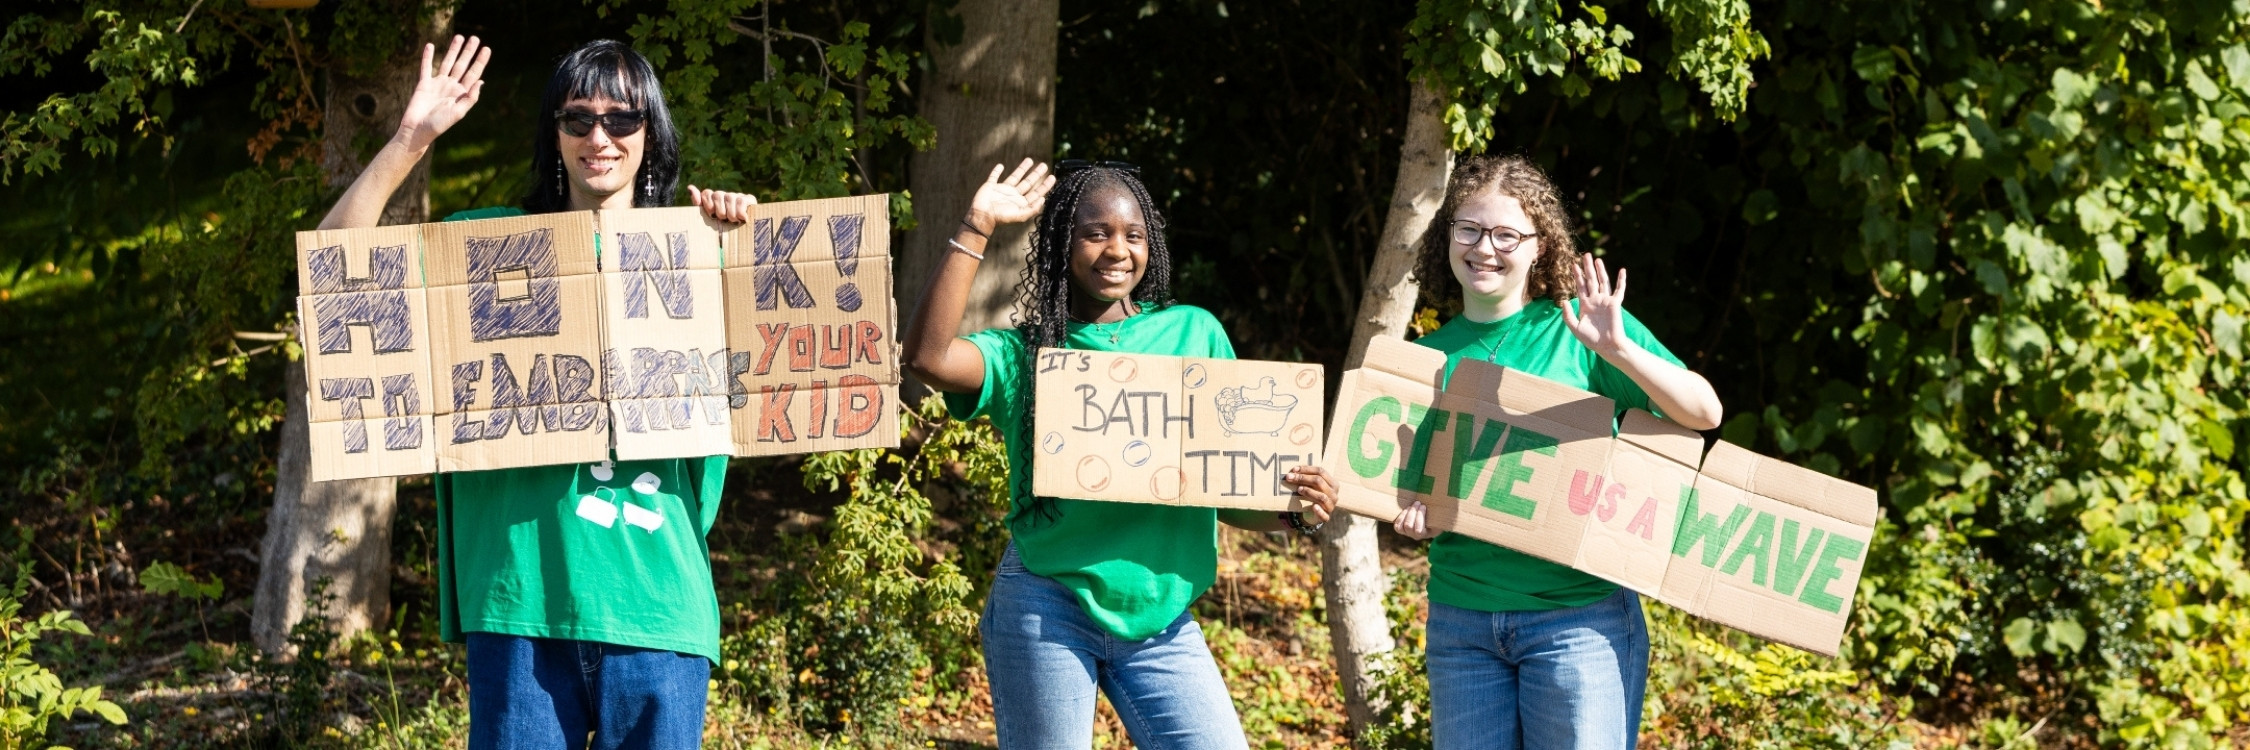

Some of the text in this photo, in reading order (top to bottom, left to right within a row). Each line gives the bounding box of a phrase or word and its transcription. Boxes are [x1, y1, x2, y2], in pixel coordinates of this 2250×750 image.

[306, 212, 865, 355] HONK!
[753, 320, 882, 376] YOUR
[1039, 350, 1093, 375] IT'S
[320, 373, 424, 454] TO
[756, 373, 883, 443] KID
[1072, 383, 1195, 440] BATH
[1346, 395, 1866, 614] GIVE US A WAVE
